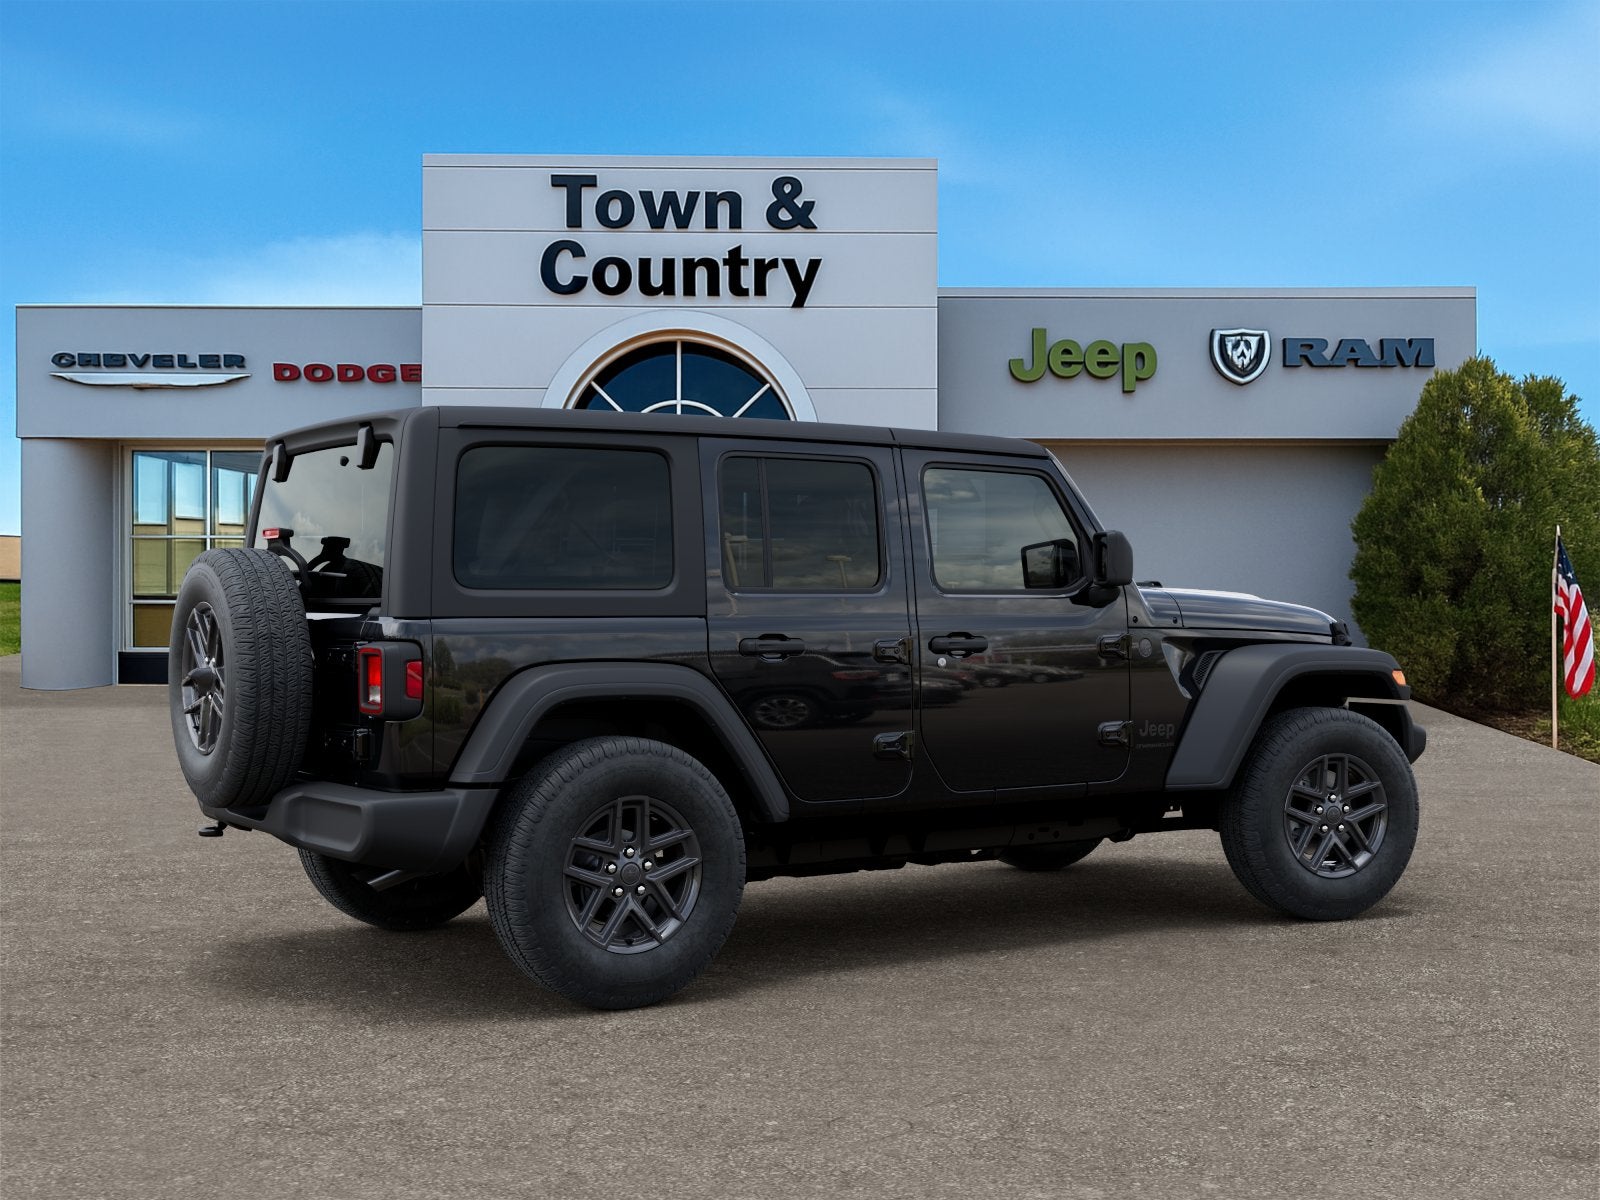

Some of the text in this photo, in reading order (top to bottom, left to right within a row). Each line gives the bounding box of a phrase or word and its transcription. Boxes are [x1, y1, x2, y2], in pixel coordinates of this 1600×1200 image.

[551, 174, 818, 230] Town &
[540, 240, 823, 308] Country
[273, 363, 422, 383] DODGE
[1009, 328, 1158, 392] Jeep
[1282, 337, 1436, 368] RAM
[1139, 720, 1175, 740] Jeep
